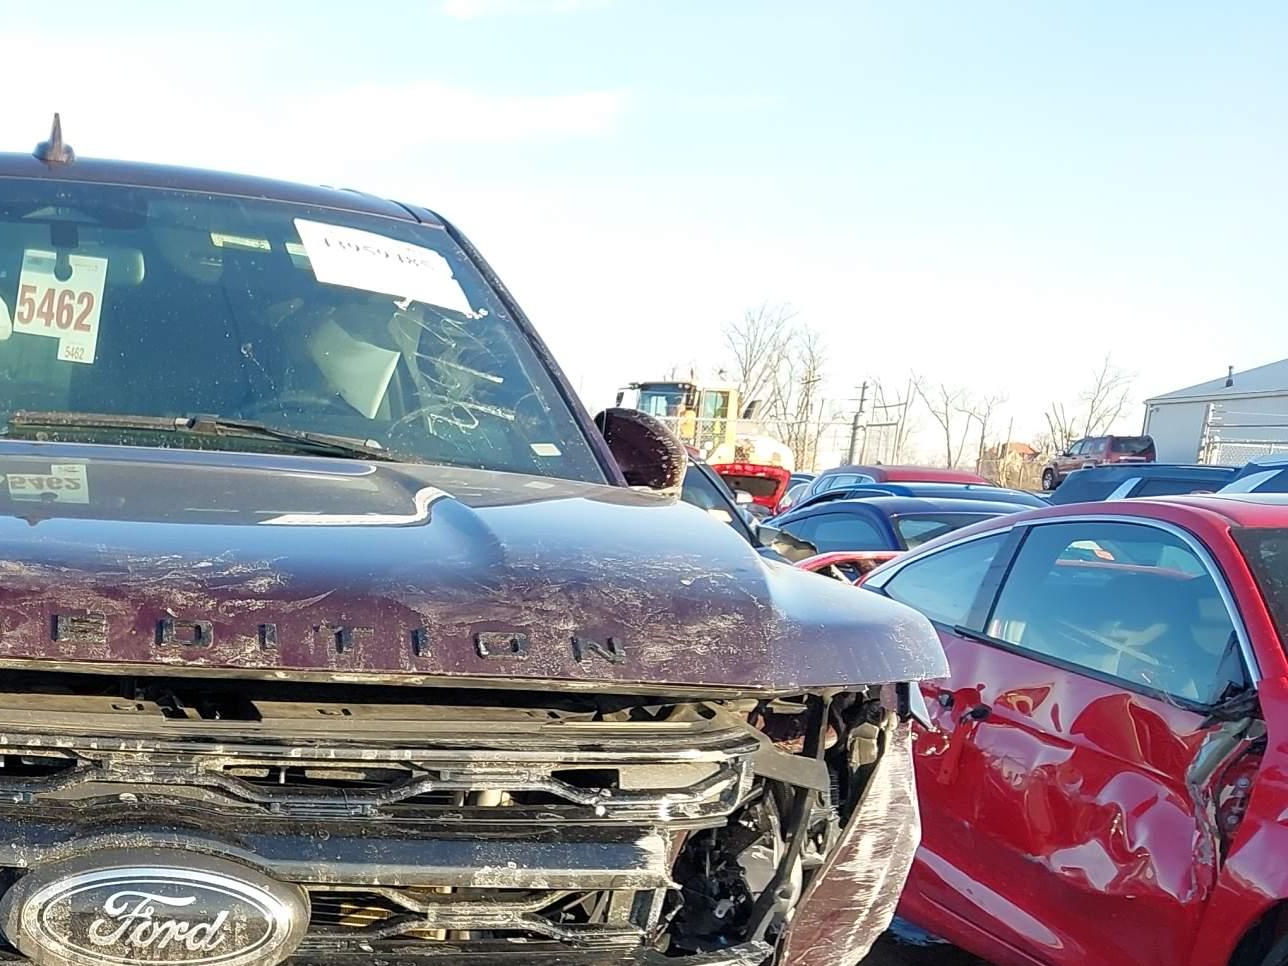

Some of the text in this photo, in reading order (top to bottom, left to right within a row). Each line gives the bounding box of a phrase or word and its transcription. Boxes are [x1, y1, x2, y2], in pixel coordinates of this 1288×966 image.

[17, 284, 95, 332] 5462
[64, 345, 85, 360] 5462
[88, 890, 230, 951] Ford
